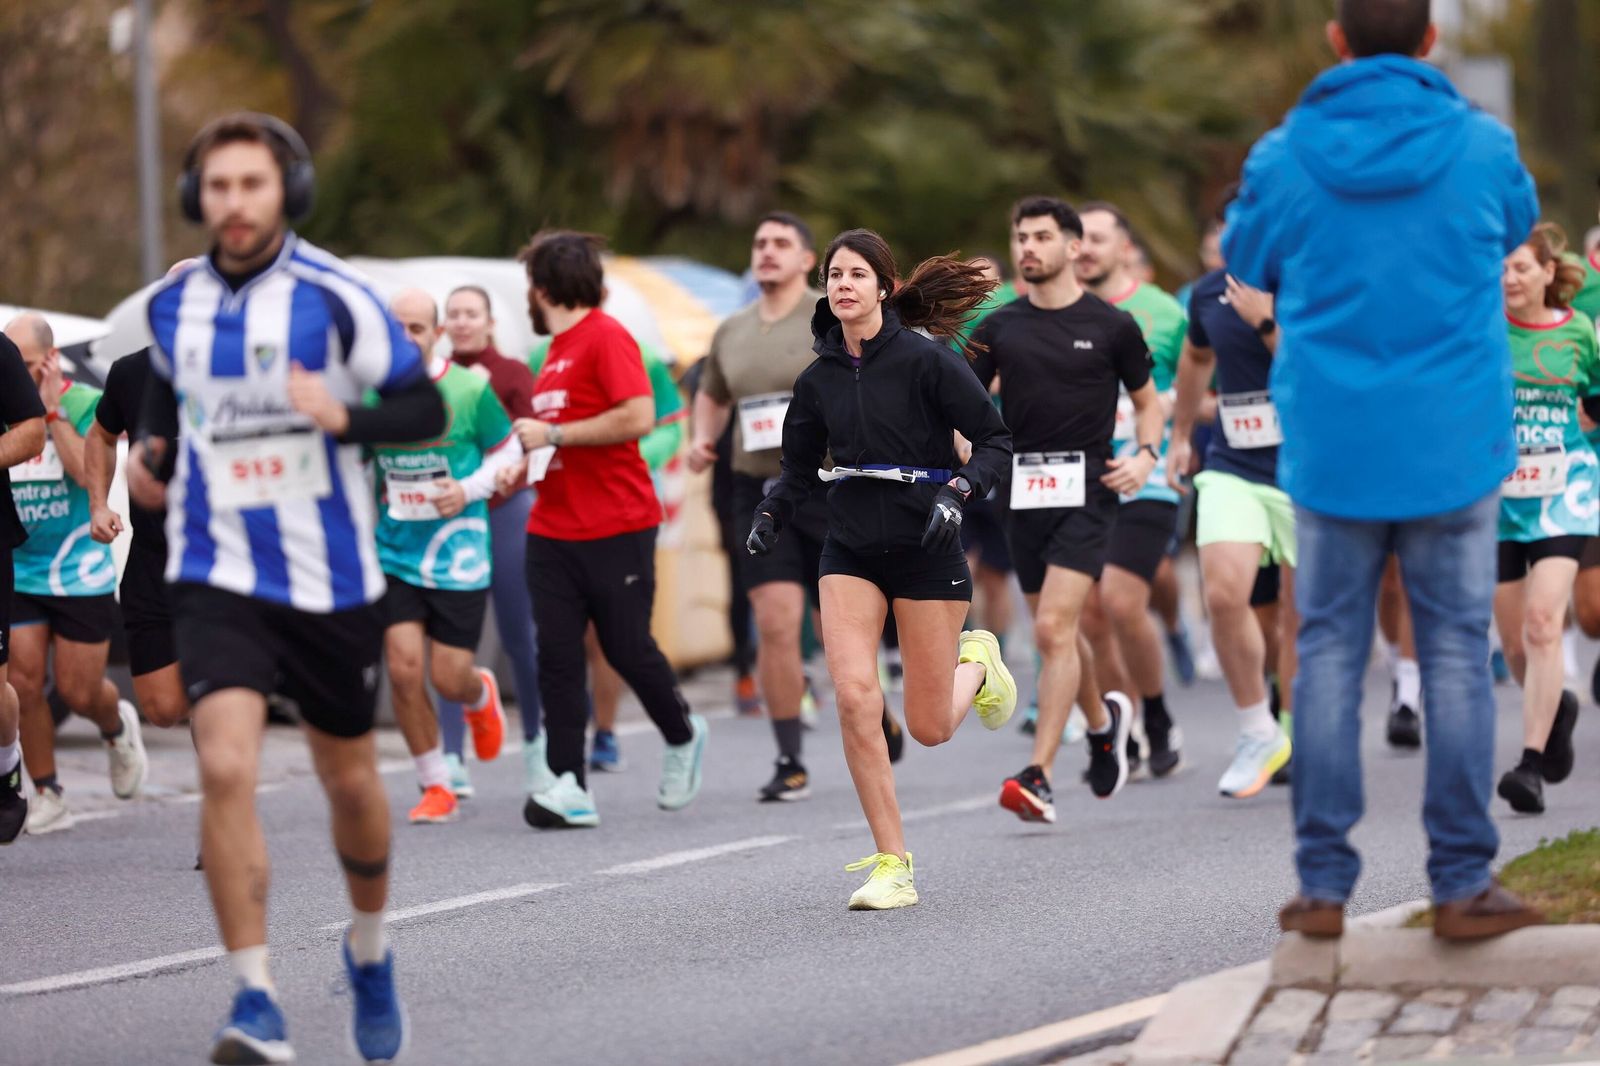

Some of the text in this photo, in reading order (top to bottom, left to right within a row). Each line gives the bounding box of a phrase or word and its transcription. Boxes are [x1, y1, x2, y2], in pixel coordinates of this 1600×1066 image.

[1233, 416, 1263, 432] 713
[232, 456, 284, 481] 513
[1027, 476, 1057, 491] 714
